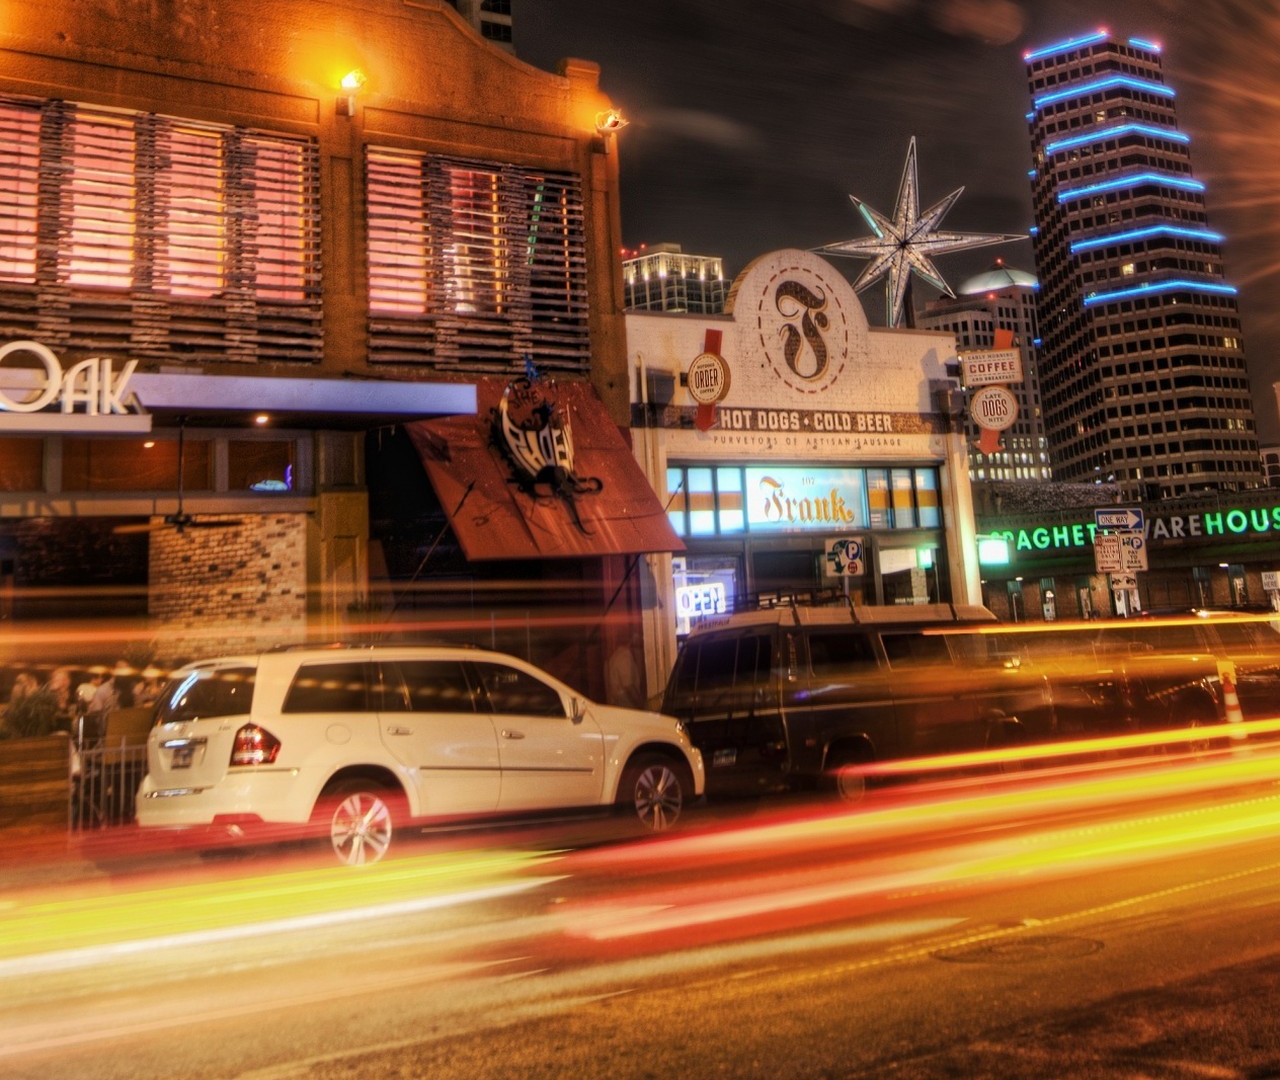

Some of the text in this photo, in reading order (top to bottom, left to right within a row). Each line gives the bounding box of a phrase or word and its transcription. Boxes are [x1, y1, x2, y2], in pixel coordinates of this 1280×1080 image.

[969, 361, 1015, 373] COFFEE
[695, 368, 718, 389] ORDER
[982, 399, 1008, 417] DOGS
[720, 409, 893, 432] HOT DOGS COLD BEER
[713, 436, 902, 447] PURVEYORS OF ARTISAN SAUSAGE
[1101, 514, 1128, 524] ONE WAY
[679, 587, 725, 616] OPEN
